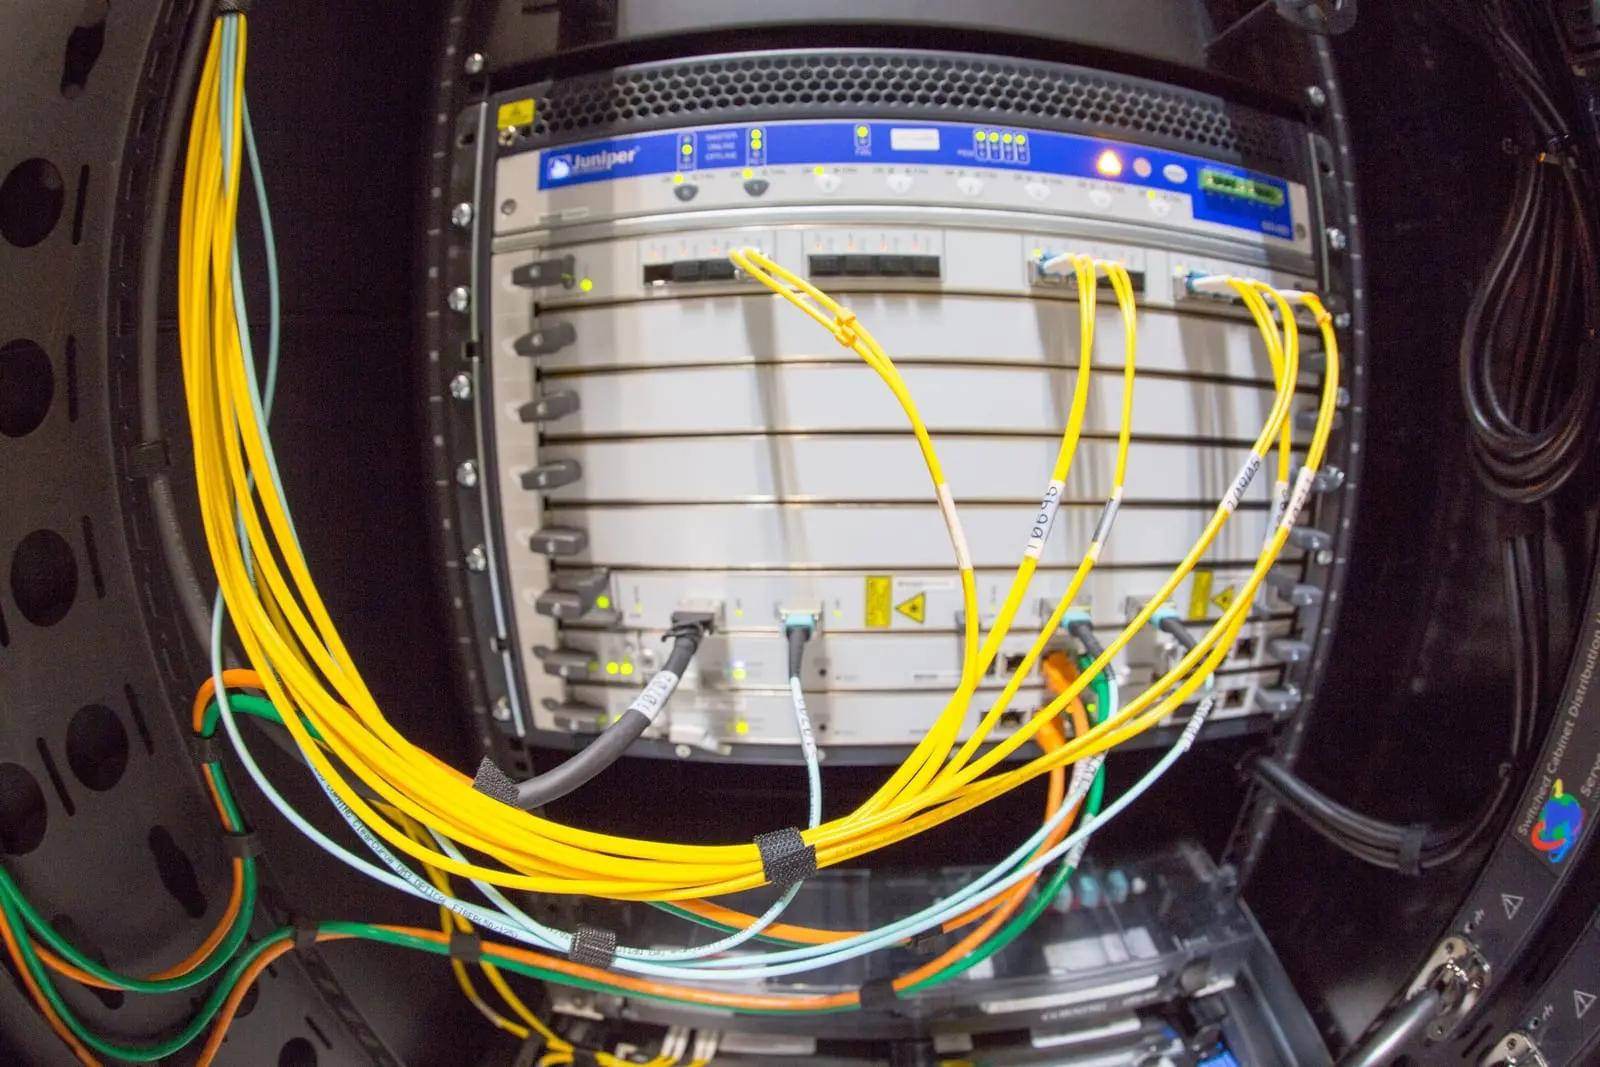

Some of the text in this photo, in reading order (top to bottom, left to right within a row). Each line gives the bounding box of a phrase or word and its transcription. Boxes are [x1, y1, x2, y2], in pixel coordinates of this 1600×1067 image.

[574, 149, 636, 171] Juniper
[1517, 775, 1552, 836] Switched
[1546, 718, 1576, 774] Cabinet
